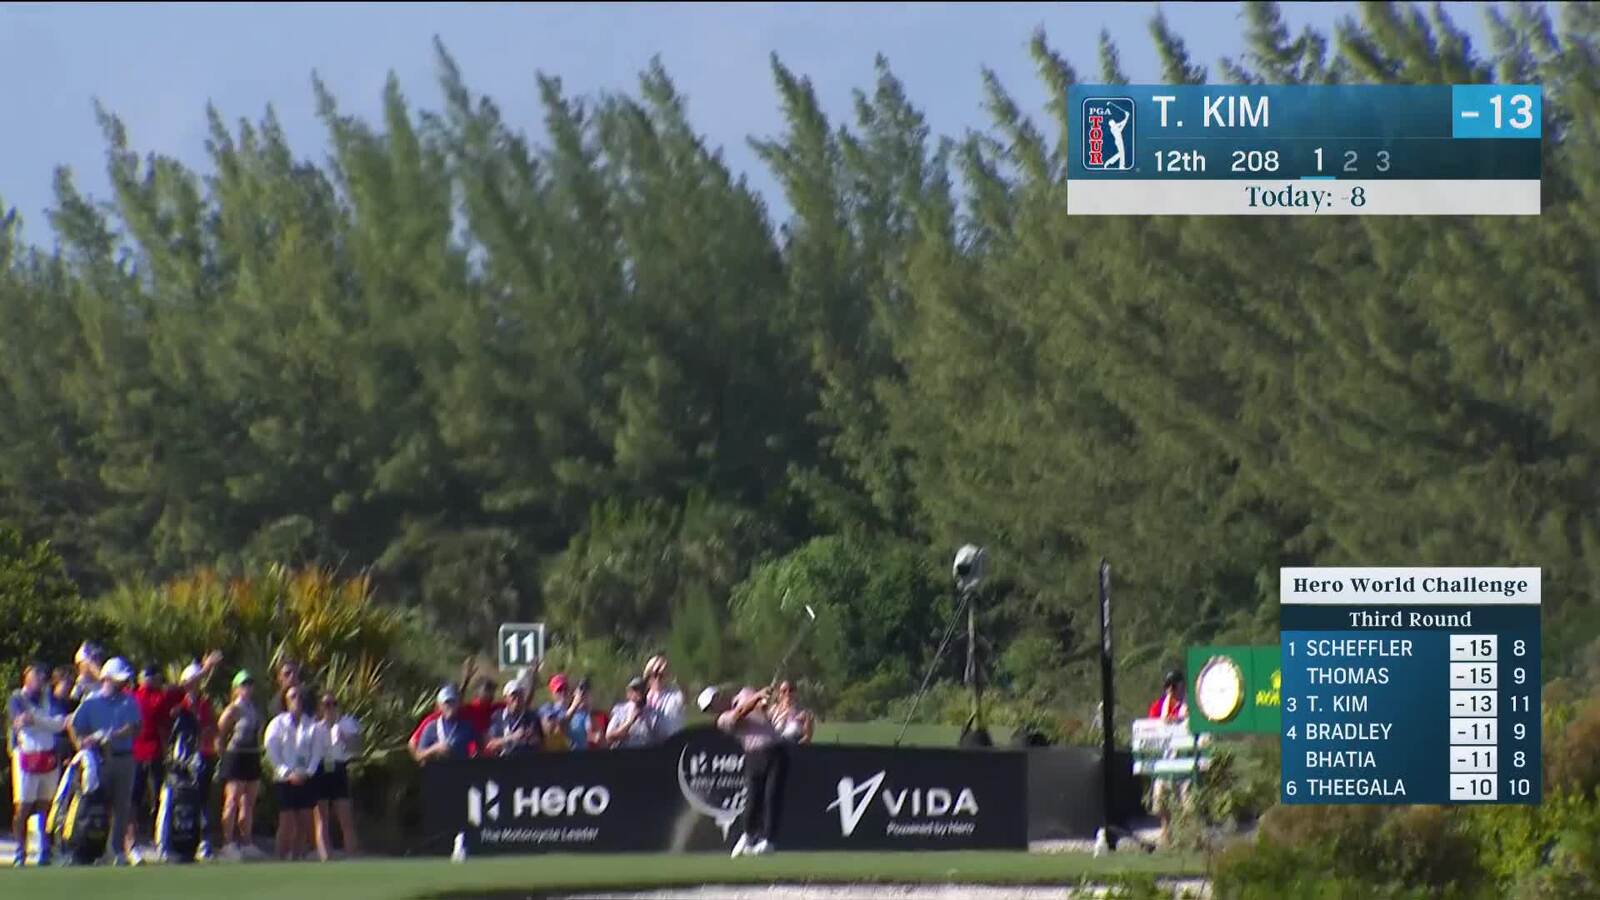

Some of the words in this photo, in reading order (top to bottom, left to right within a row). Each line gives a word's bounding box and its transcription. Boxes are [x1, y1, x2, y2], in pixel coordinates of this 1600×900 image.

[505, 632, 535, 663] 11
[513, 785, 610, 817] Hero
[882, 787, 979, 817] VIDA
